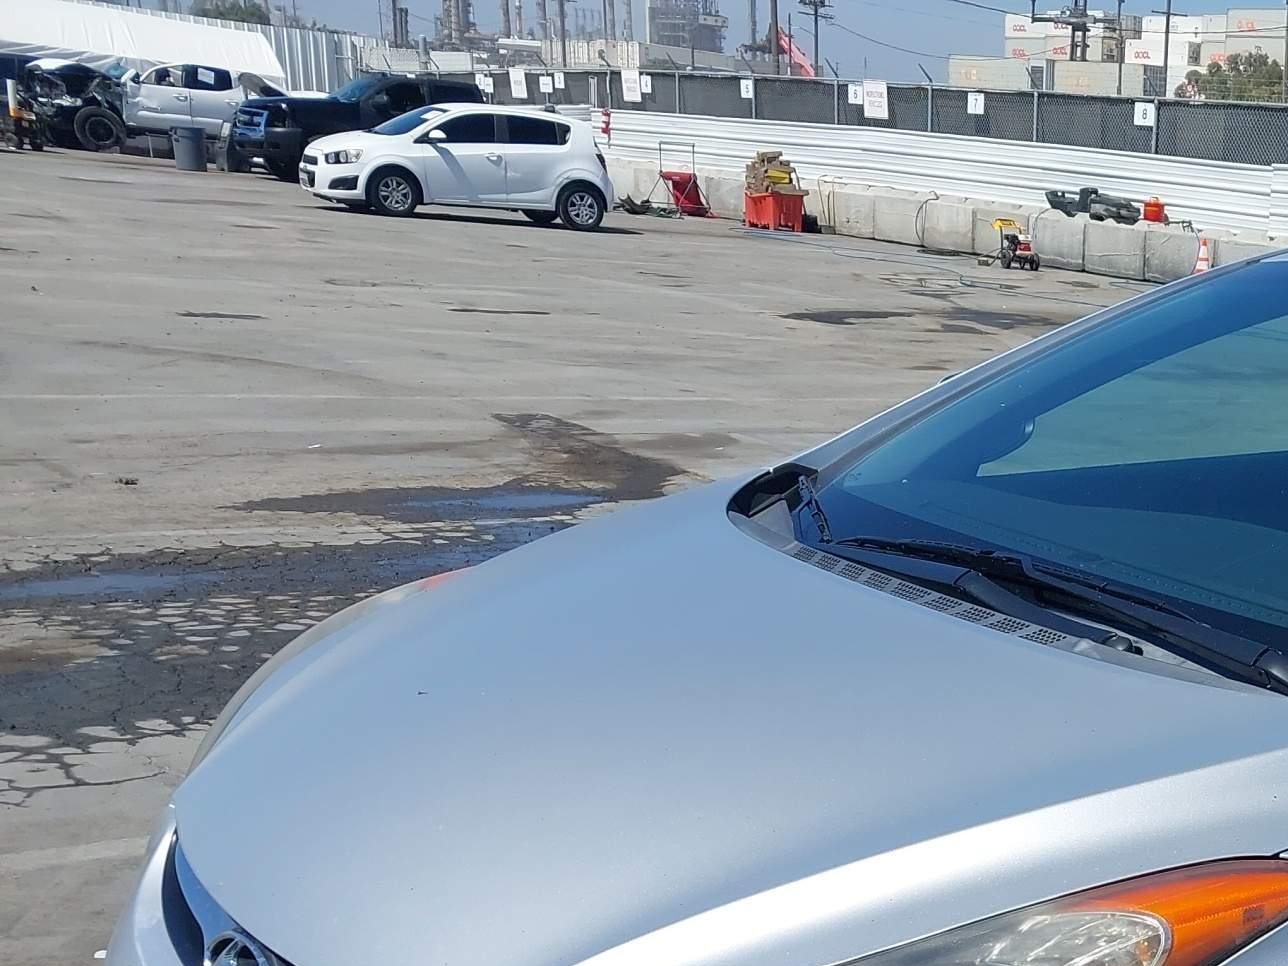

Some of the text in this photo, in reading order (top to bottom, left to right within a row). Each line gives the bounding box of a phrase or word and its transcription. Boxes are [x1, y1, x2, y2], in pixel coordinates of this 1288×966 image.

[853, 89, 858, 99] 6
[973, 98, 978, 112] 7
[1142, 108, 1147, 120] 8
